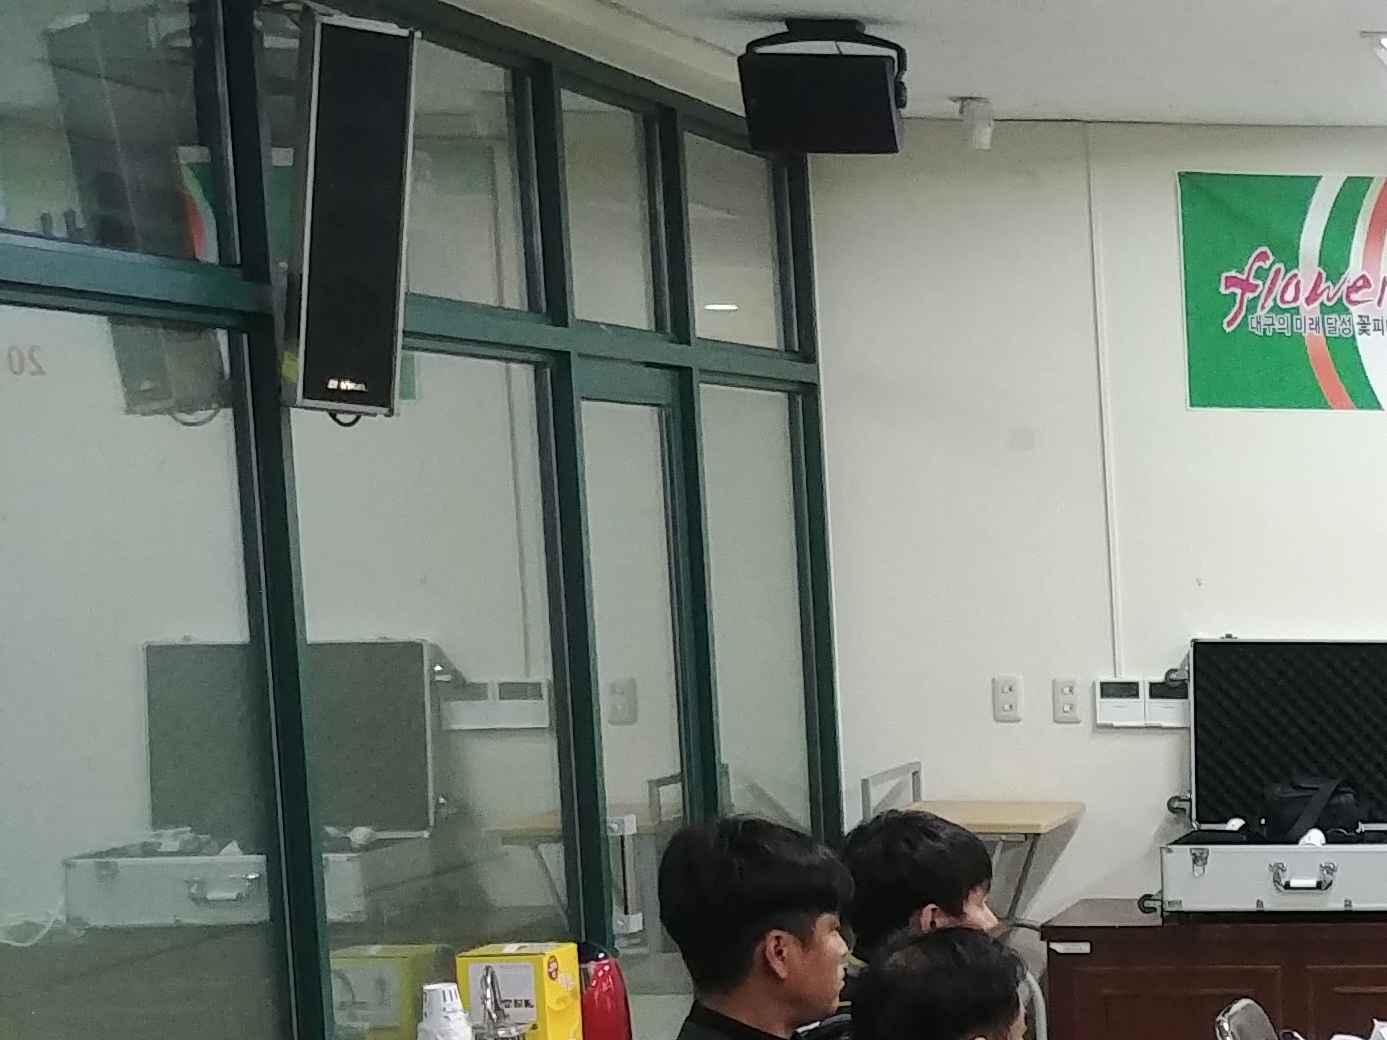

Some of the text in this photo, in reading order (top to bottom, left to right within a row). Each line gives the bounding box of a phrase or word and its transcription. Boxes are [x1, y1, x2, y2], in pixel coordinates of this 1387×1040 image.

[1250, 314, 1291, 335] 대구의
[1295, 315, 1321, 334] 미래
[1326, 315, 1353, 335] 달성
